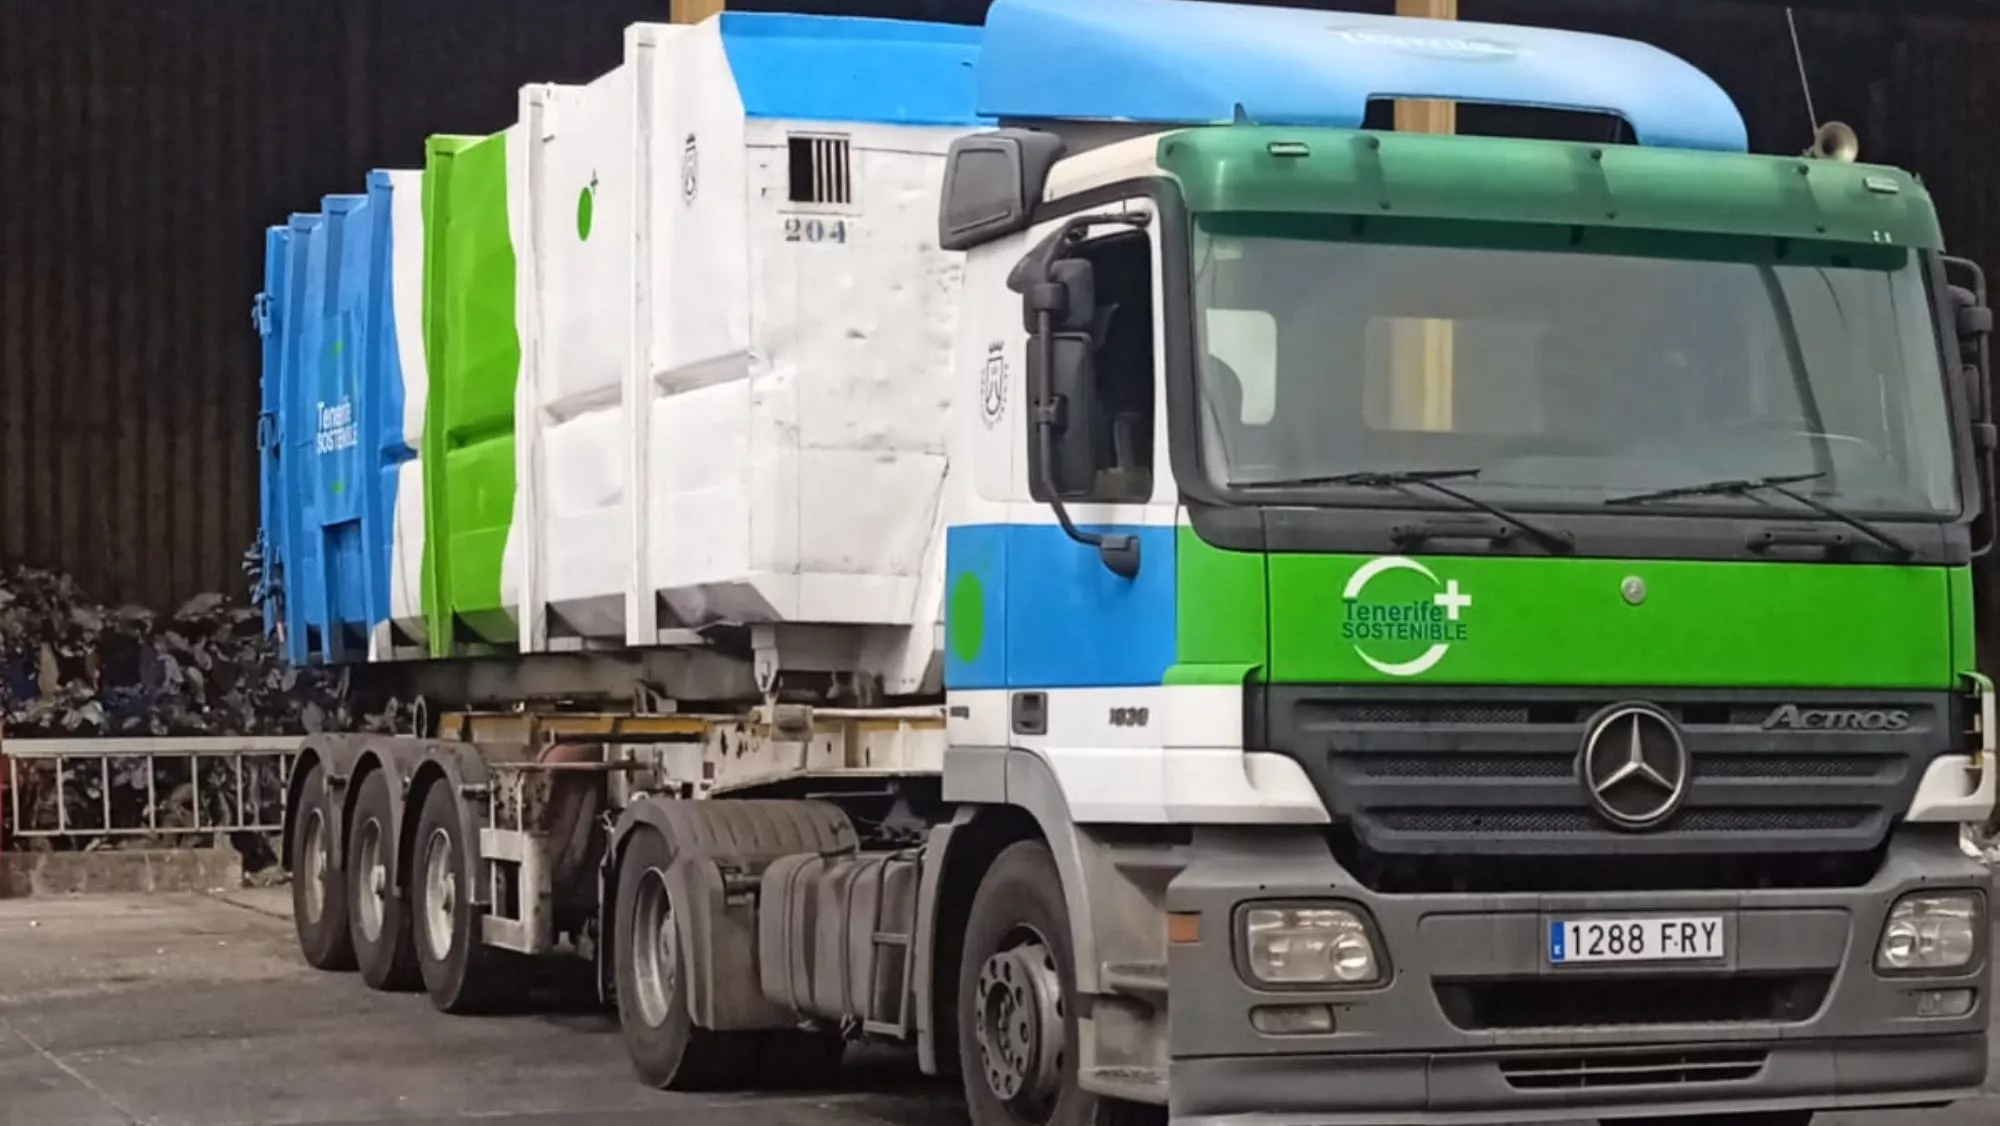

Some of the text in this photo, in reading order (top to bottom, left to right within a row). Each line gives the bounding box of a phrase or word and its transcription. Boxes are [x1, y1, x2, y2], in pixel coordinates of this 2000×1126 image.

[785, 217, 846, 243] 204
[1342, 599, 1442, 622] Tenerife
[1342, 623, 1468, 641] SOSTENIBLE
[1572, 921, 1717, 956] 1288 FRY
